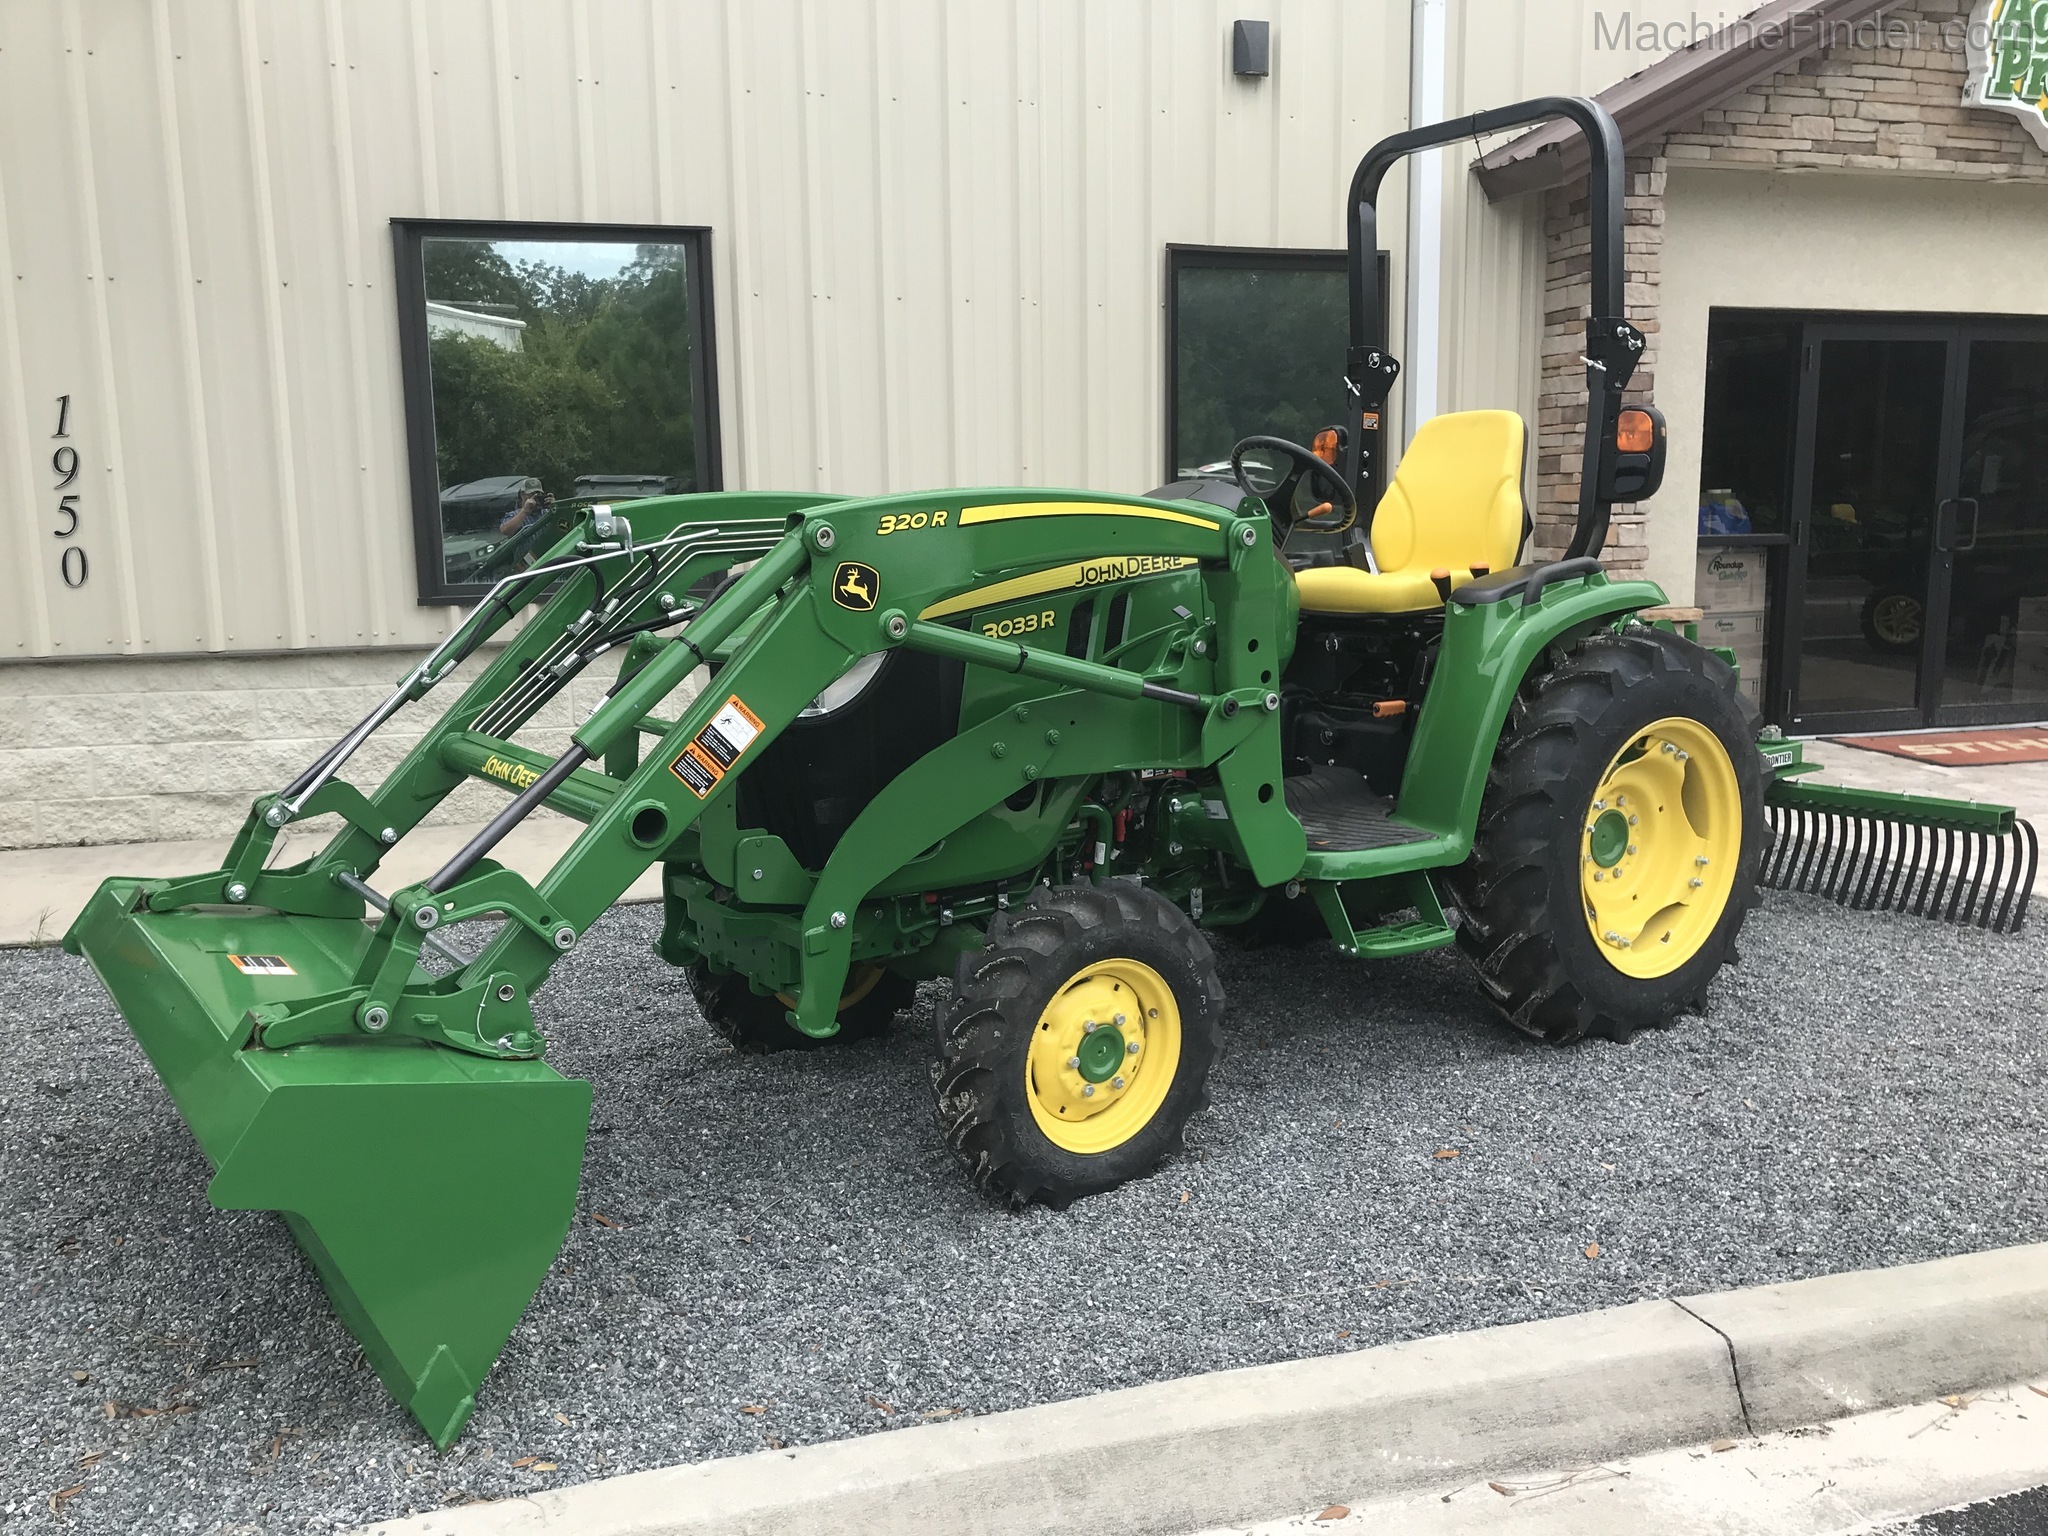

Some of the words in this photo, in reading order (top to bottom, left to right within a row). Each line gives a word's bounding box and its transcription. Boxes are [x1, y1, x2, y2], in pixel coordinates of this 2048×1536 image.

[51, 394, 88, 588] 1950
[877, 512, 928, 535] 320
[930, 510, 948, 528] R
[1075, 561, 1124, 587] JOHN
[1127, 556, 1183, 576] DEERE
[983, 614, 1039, 639] 3033
[1041, 610, 1056, 630] R
[738, 704, 761, 729] WARNING
[1898, 738, 2048, 756] STIH
[482, 754, 513, 781] JOHN
[510, 765, 541, 789] DEE
[696, 752, 720, 776] WARNING
